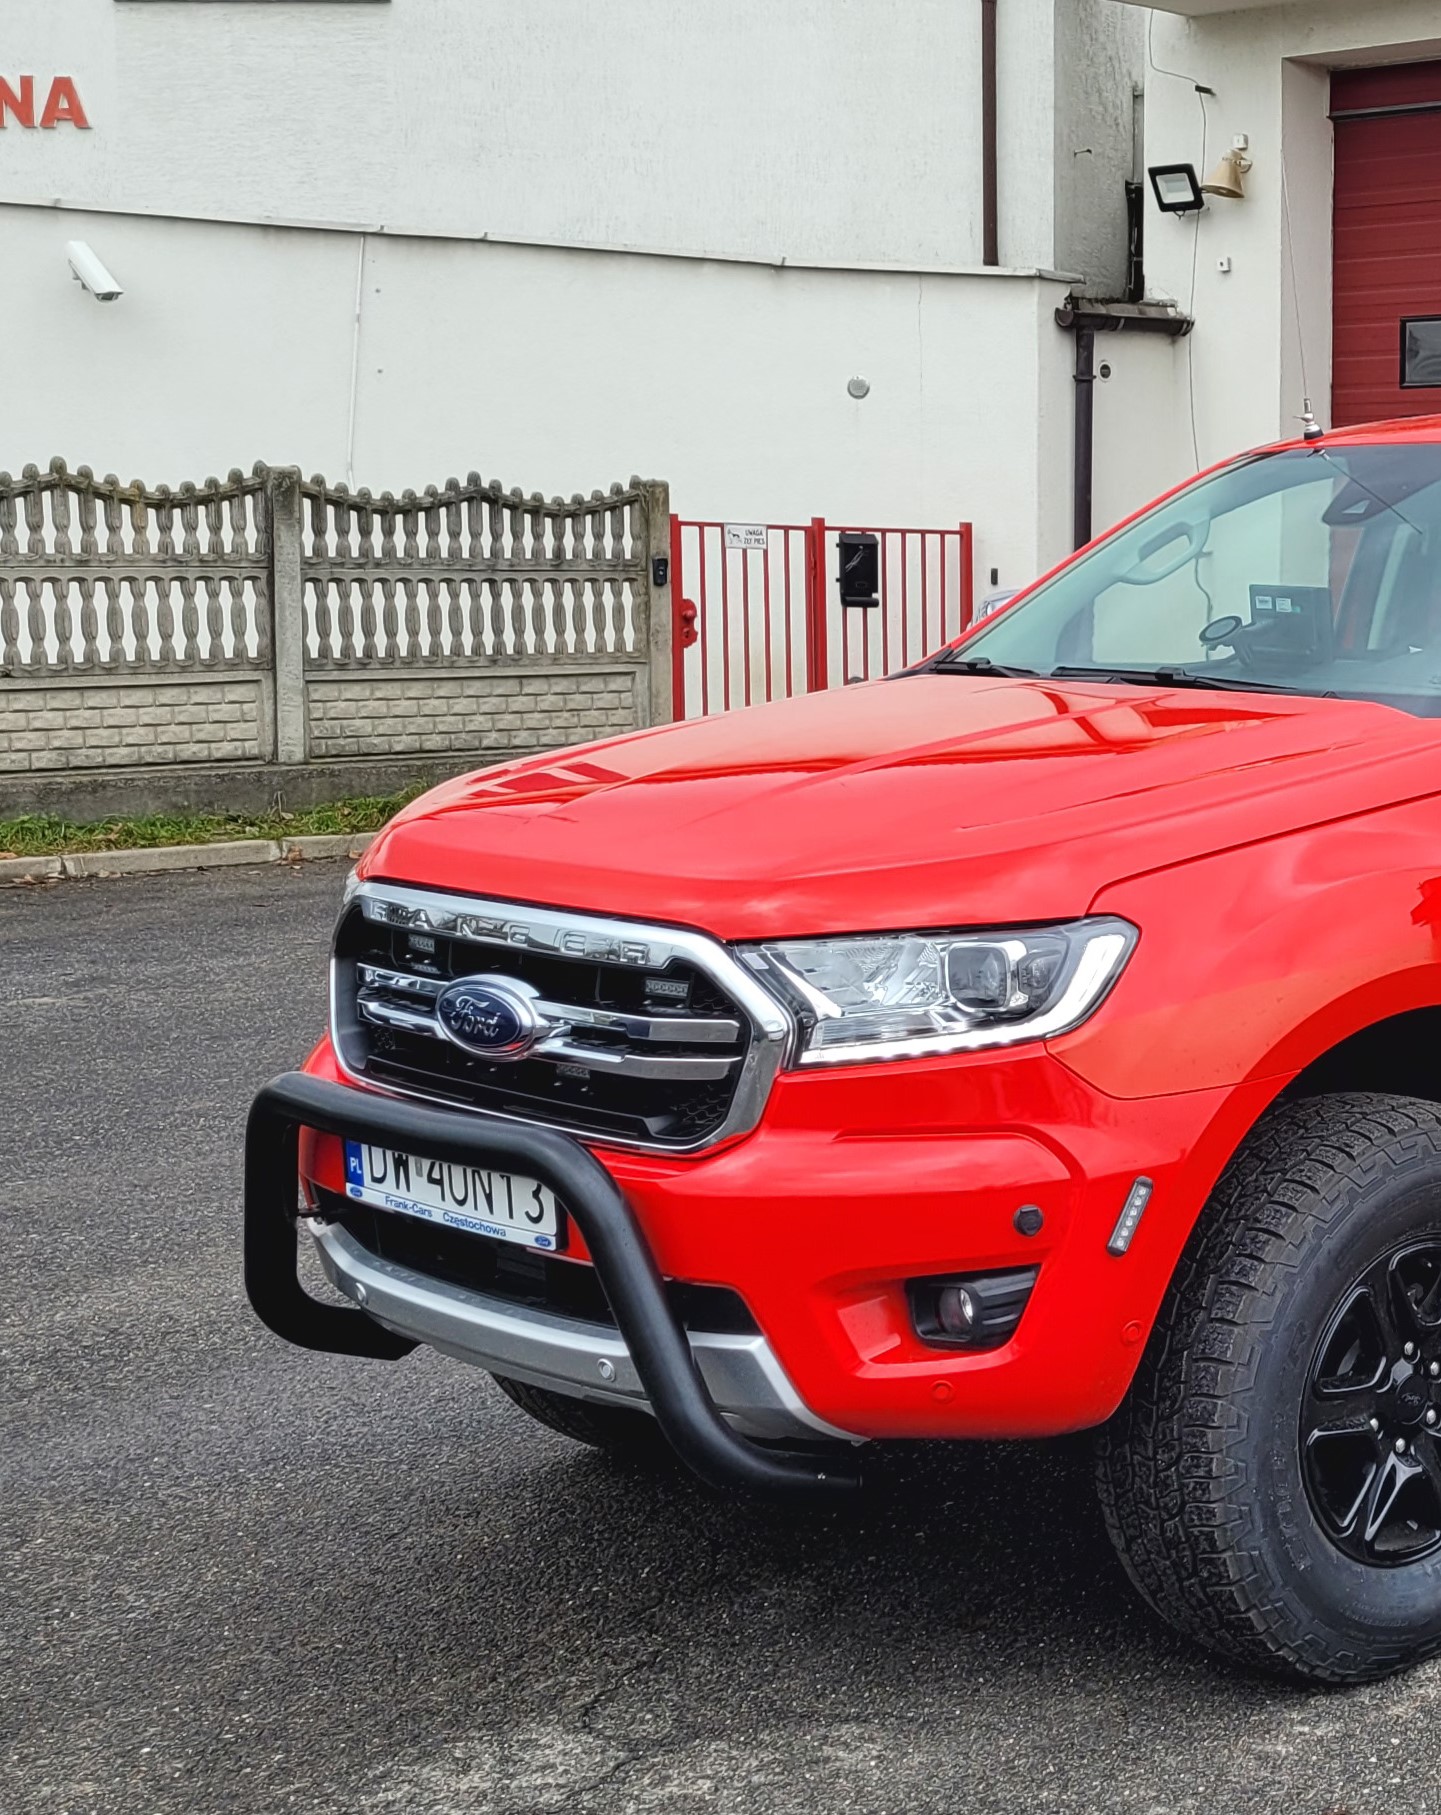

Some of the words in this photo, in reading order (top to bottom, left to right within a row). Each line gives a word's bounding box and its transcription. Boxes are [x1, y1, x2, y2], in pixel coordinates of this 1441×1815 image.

[370, 900, 650, 965] RANGER
[448, 995, 502, 1038] Ford
[350, 1156, 362, 1174] PL
[384, 1195, 433, 1219] Frank-Cars
[442, 1212, 507, 1239] Częstochowa
